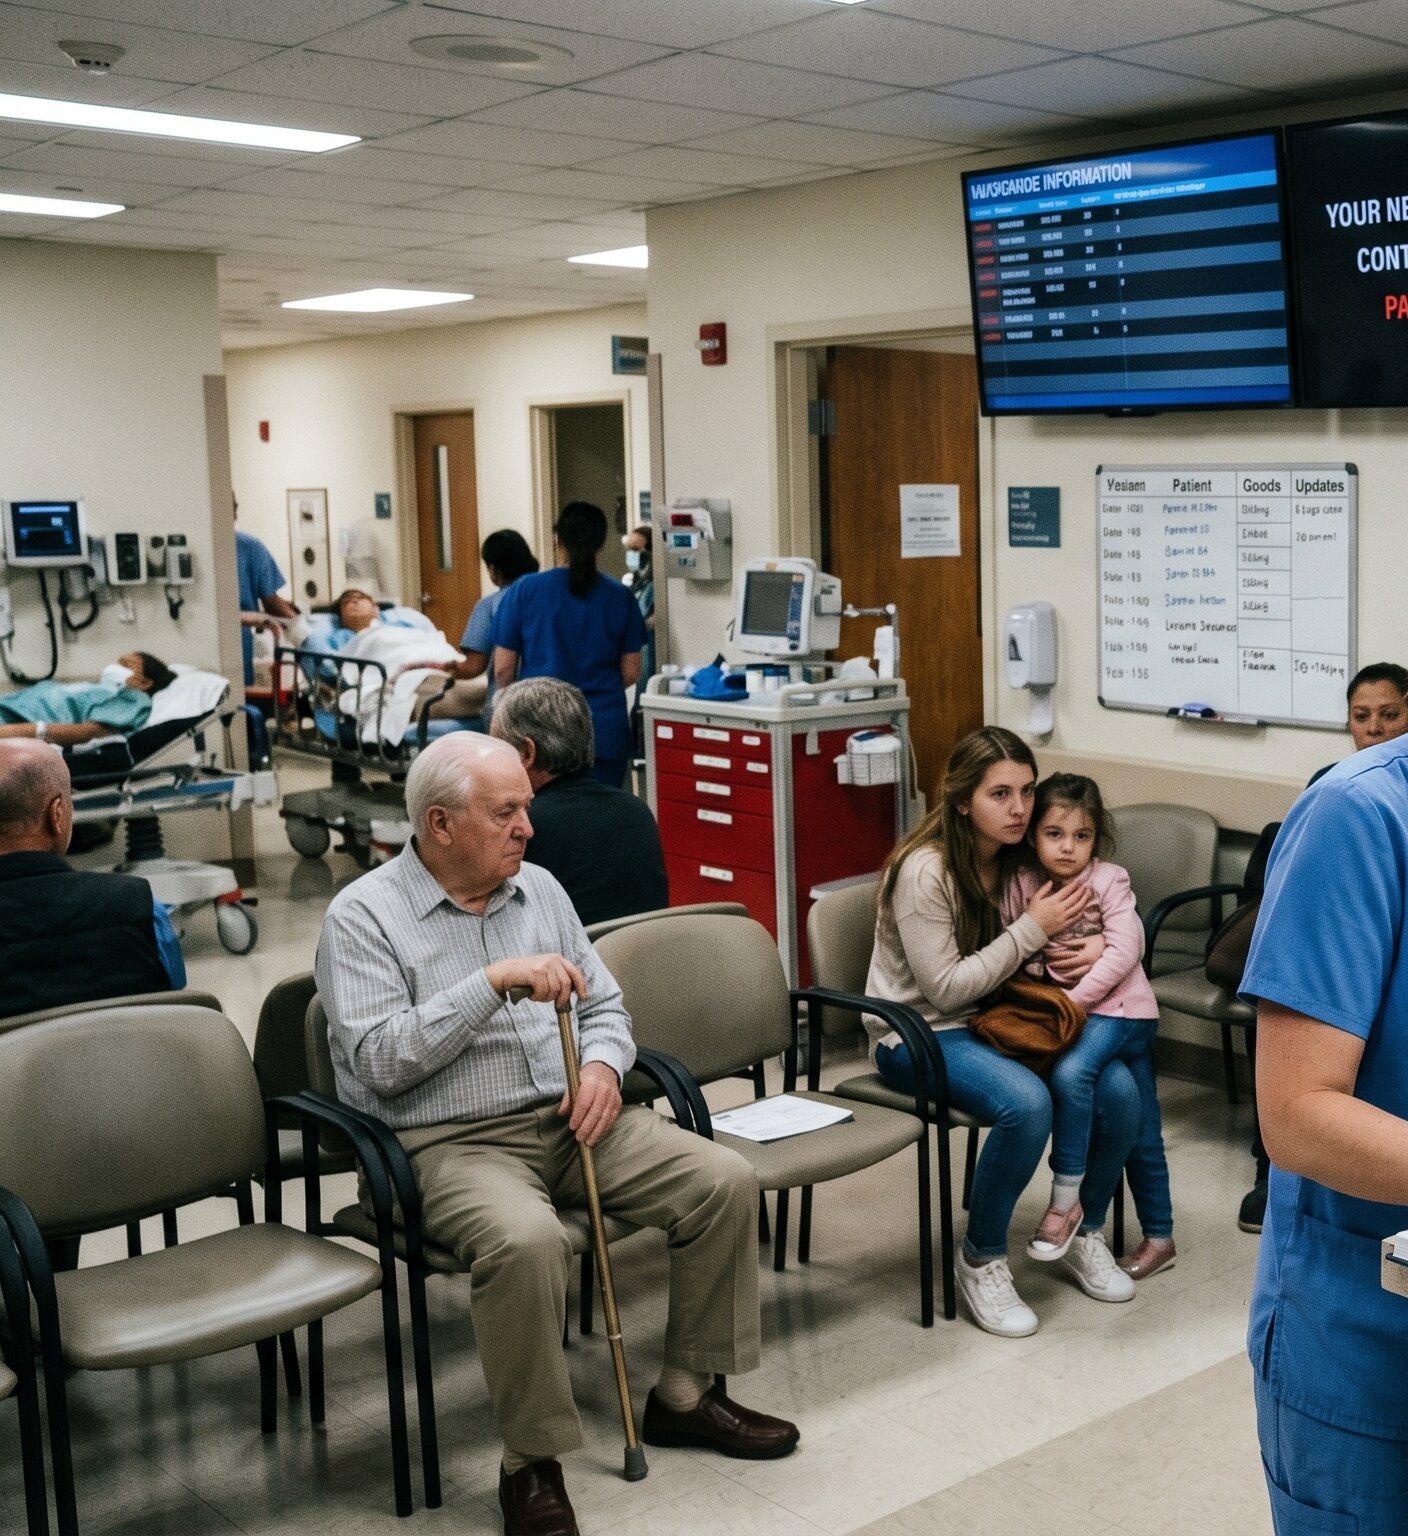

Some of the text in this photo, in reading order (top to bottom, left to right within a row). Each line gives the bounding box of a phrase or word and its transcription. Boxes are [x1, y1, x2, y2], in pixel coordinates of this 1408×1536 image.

[1043, 162, 1131, 189] INFORMATION
[1326, 200, 1381, 228] YOUR
[1173, 479, 1212, 492] Patient
[1243, 479, 1281, 492] Goods
[1296, 479, 1344, 495] Updates
